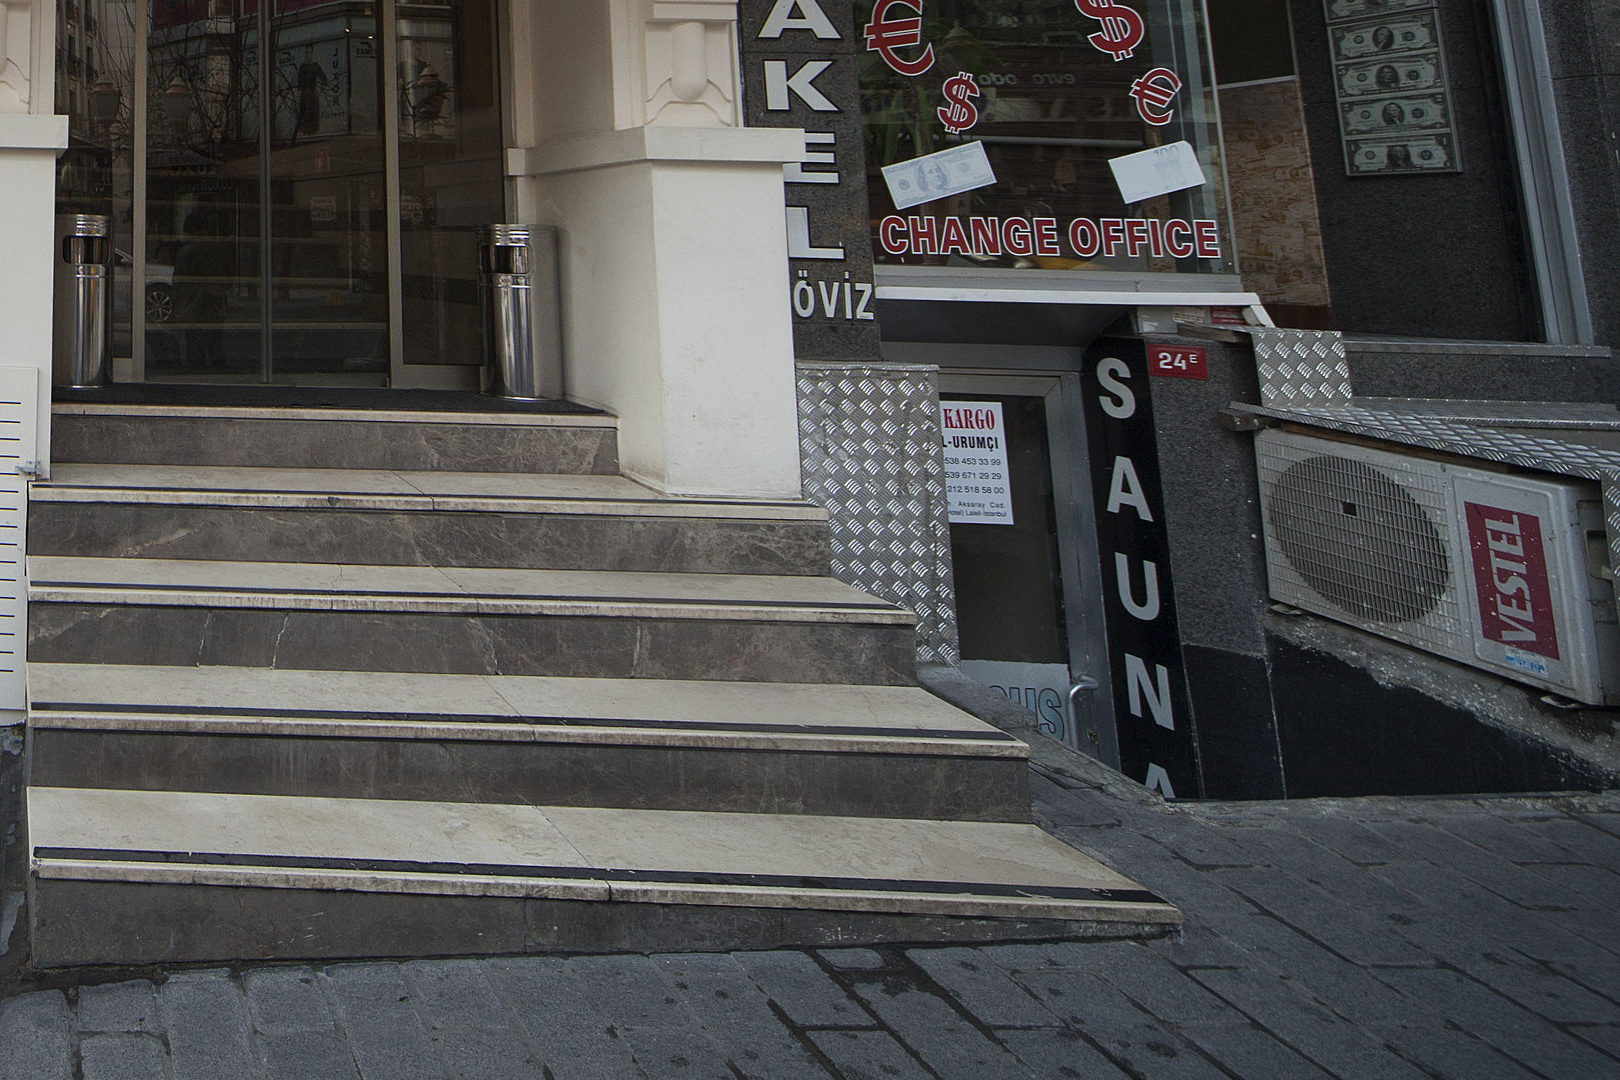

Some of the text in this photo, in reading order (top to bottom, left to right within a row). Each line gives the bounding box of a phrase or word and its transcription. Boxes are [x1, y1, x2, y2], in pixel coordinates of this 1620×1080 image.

[879, 215, 1221, 259] CHANGE OFFICE
[943, 408, 995, 430] KARGO
[978, 458, 989, 466] 33
[991, 458, 1001, 466] 99
[979, 472, 989, 480] 29
[991, 472, 1002, 480] 29
[947, 485, 962, 493] 212
[958, 501, 985, 509] Aksaray
[1485, 514, 1537, 641] VESTEL
